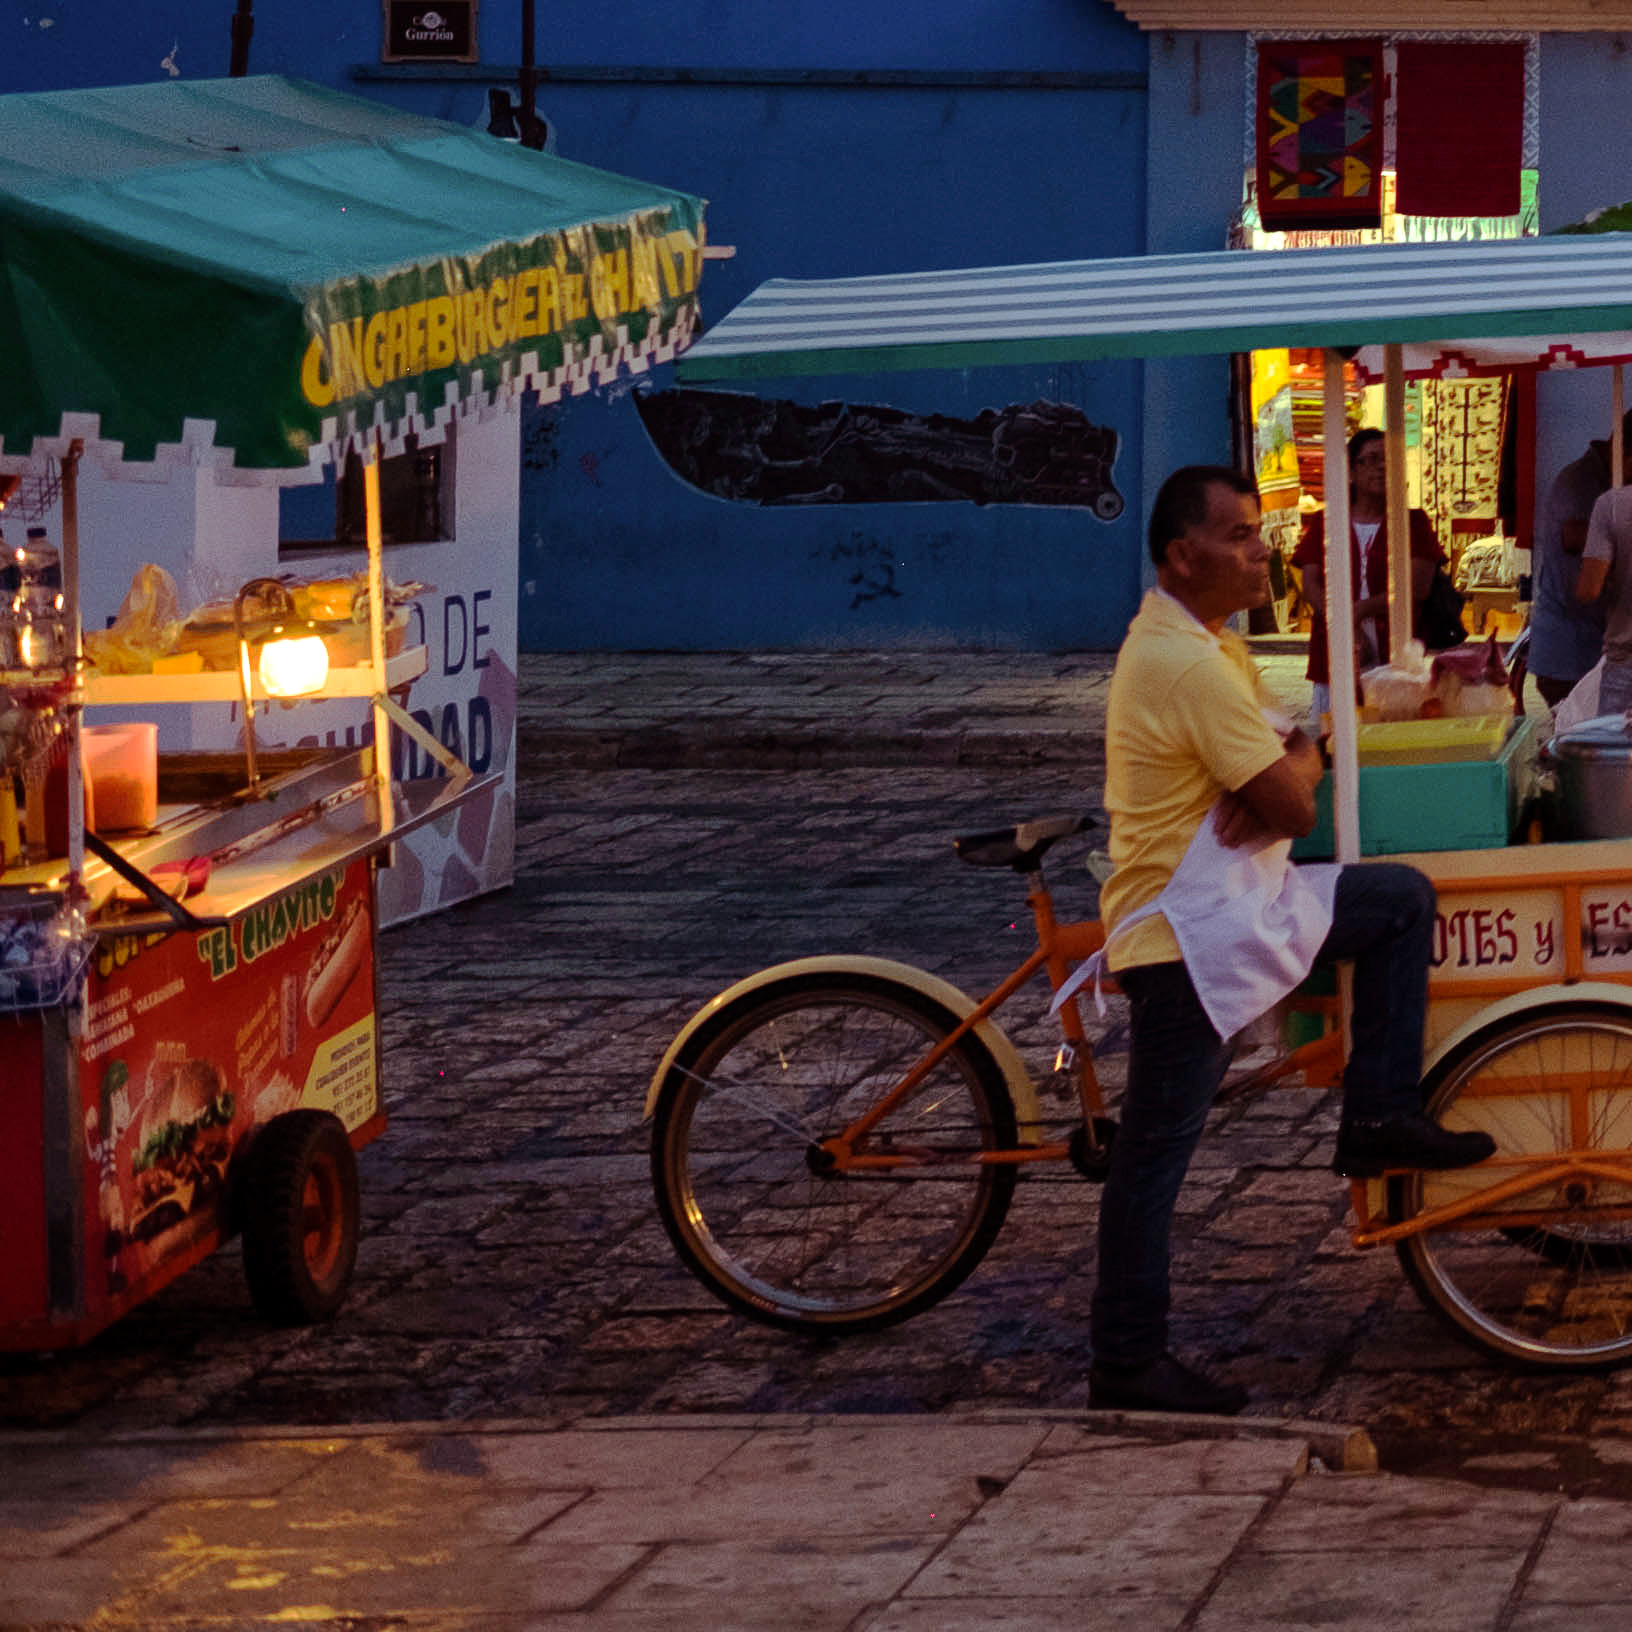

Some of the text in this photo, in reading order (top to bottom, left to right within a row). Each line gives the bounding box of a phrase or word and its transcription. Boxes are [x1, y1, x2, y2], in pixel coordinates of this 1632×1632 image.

[404, 27, 454, 41] Gurrión
[444, 590, 492, 676] DE
[1534, 918, 1554, 965] y
